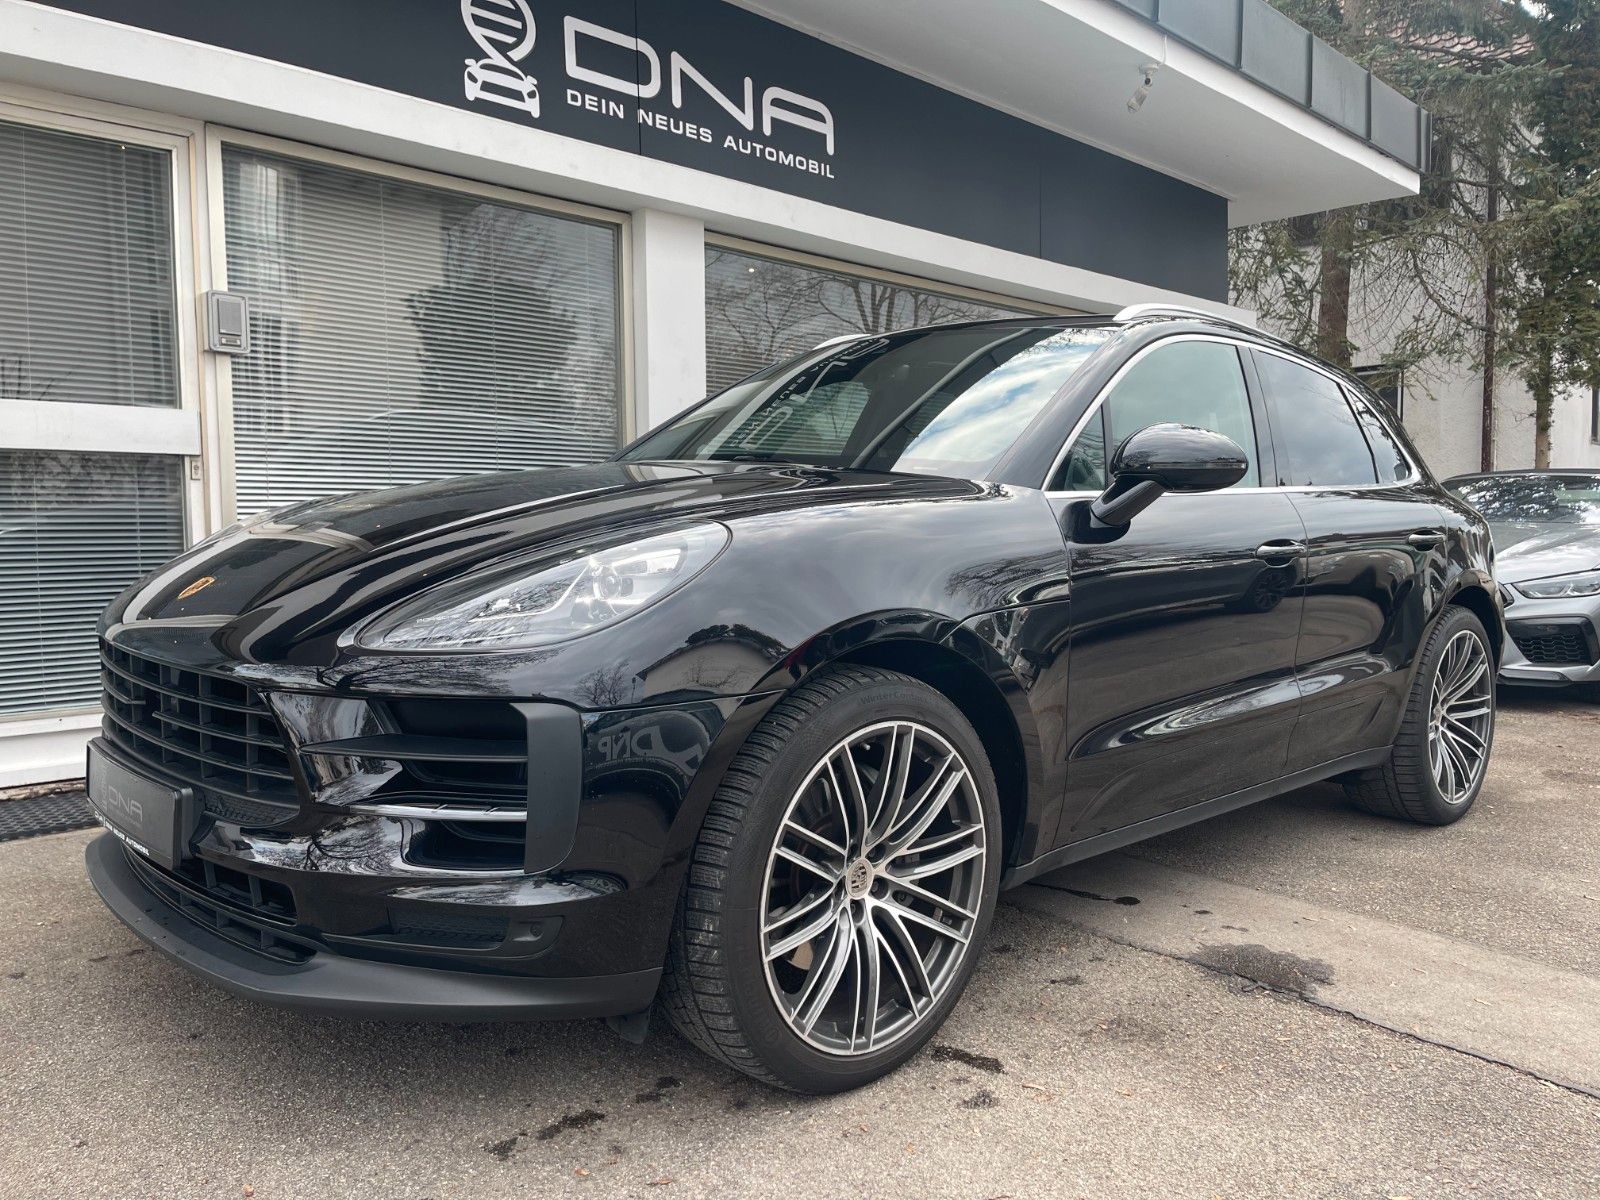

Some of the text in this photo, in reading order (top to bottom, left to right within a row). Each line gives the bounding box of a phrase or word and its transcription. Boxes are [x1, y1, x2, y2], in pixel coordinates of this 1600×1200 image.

[564, 15, 835, 156] DNA
[566, 88, 834, 179] DEIN NEUES AUTOMOBIL
[108, 785, 143, 822] DNA
